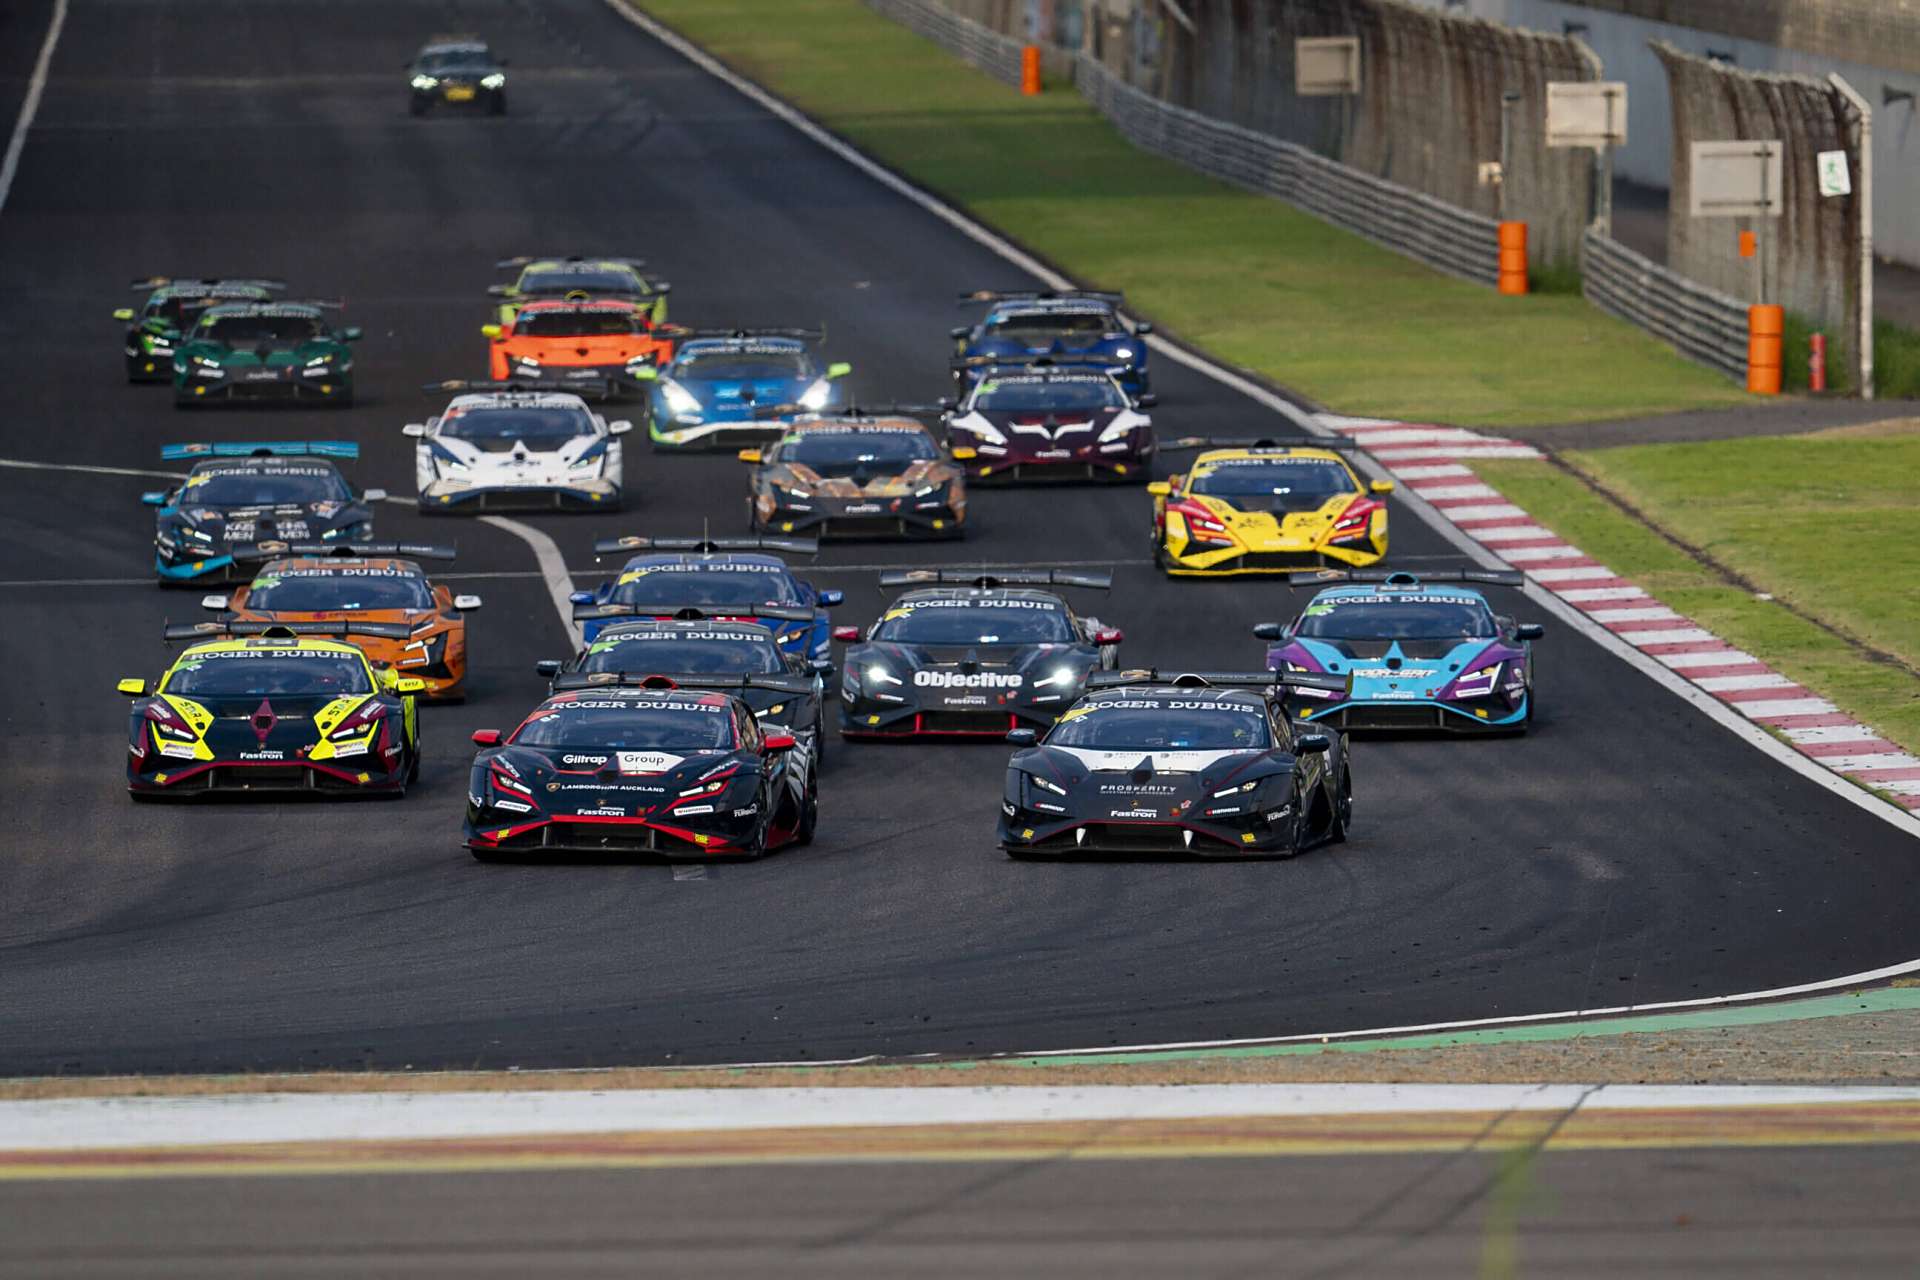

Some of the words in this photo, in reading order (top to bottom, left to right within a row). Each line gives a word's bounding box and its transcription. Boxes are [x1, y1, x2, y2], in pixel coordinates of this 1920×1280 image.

[342, 568, 415, 578] DUBUIS
[901, 599, 971, 609] ROGER
[979, 599, 1055, 610] DUBUIS
[1322, 595, 1392, 605] ROGER
[1400, 595, 1476, 605] DUBUIS
[605, 631, 677, 642] ROGER
[685, 631, 764, 642] DUBUIS
[190, 650, 263, 660] ROGER
[271, 650, 352, 659] DUBUIS
[913, 670, 1023, 689] Objective
[549, 700, 627, 710] ROGER
[635, 701, 721, 713] DUBUIS
[1083, 700, 1160, 710] ROGER
[1167, 701, 1254, 713] DUBUIS
[239, 750, 284, 761] Fastron
[562, 754, 608, 766] Giltrap
[624, 754, 665, 766] Group
[620, 785, 665, 793] AUCKLAND
[1100, 784, 1177, 792] PROSPERITY
[577, 808, 625, 818] Fastron
[1110, 809, 1157, 818] Fastron
